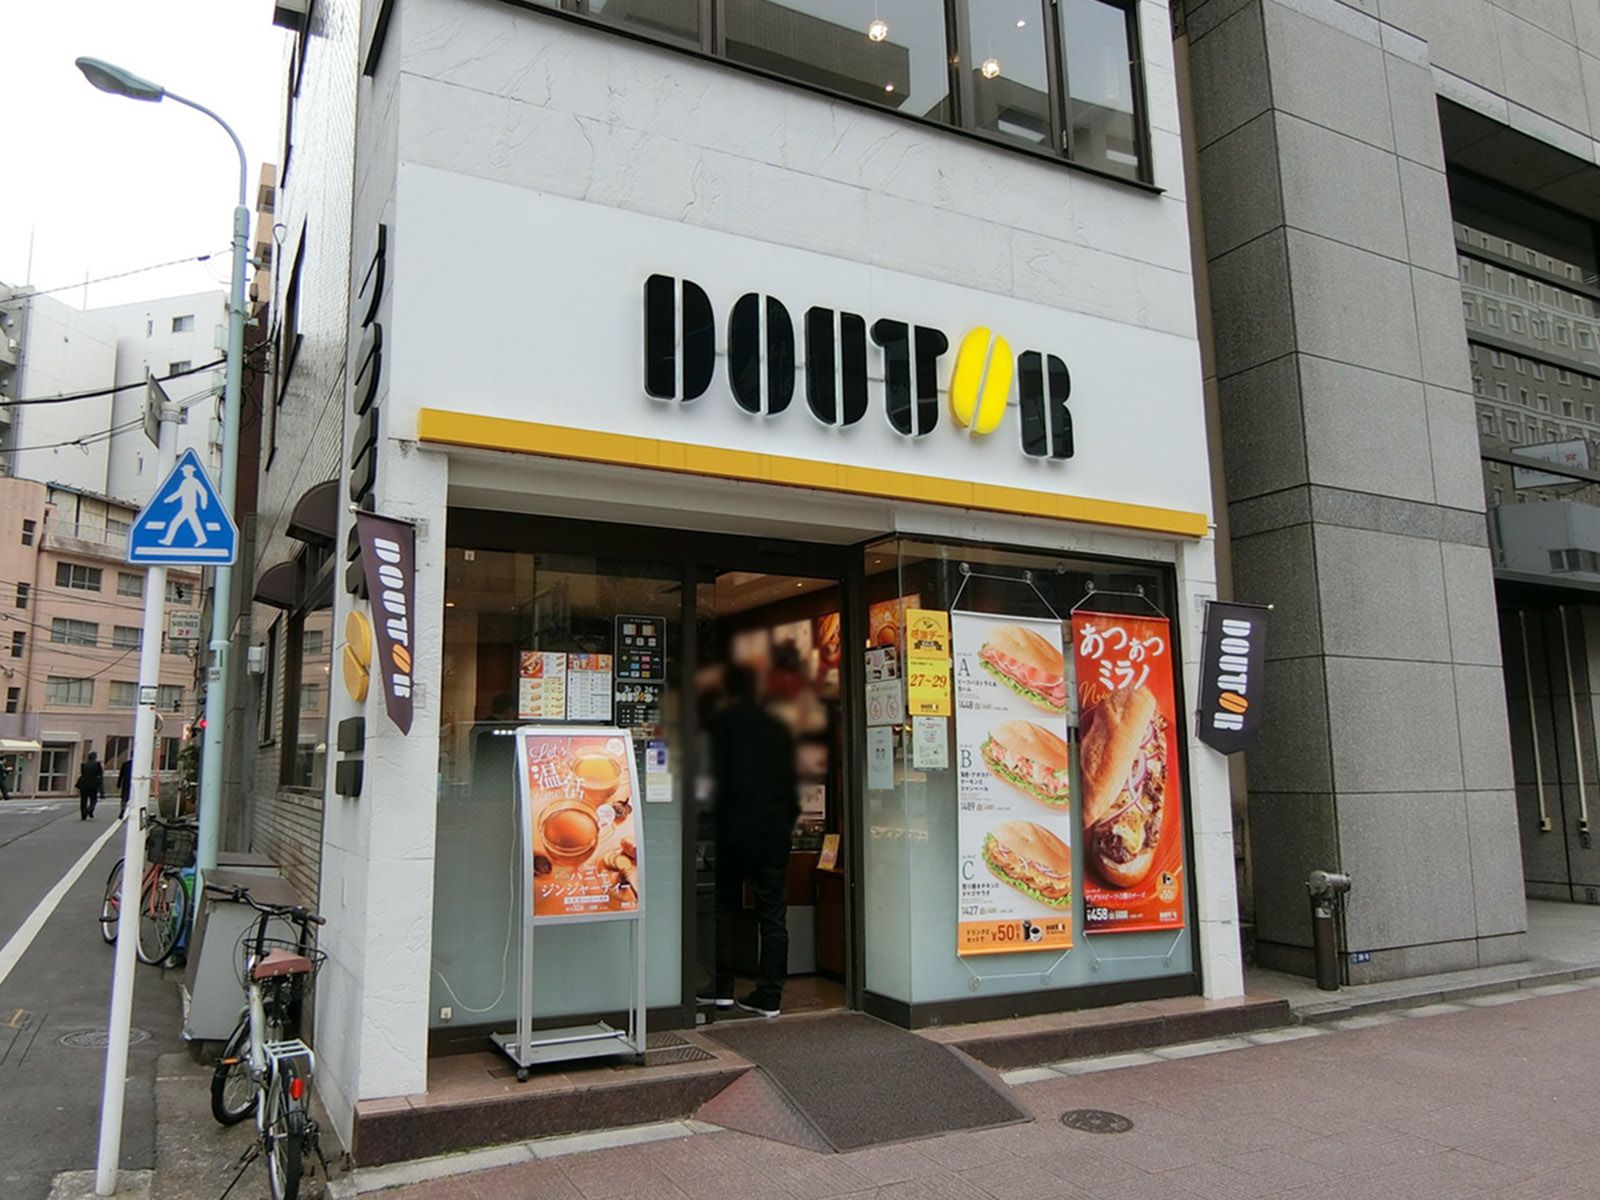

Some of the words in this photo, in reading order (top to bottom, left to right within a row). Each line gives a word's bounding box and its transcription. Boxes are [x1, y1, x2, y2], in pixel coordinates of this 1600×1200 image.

[642, 272, 1076, 461] DOUTOR
[373, 537, 412, 699] DOUTOR
[957, 658, 971, 677] A
[1098, 660, 1150, 691] ミラノ
[1212, 618, 1252, 732] DOUTOR
[960, 748, 973, 769] B
[530, 761, 587, 801] 温活
[962, 860, 975, 881] C
[541, 880, 632, 899] ジンジャーティー
